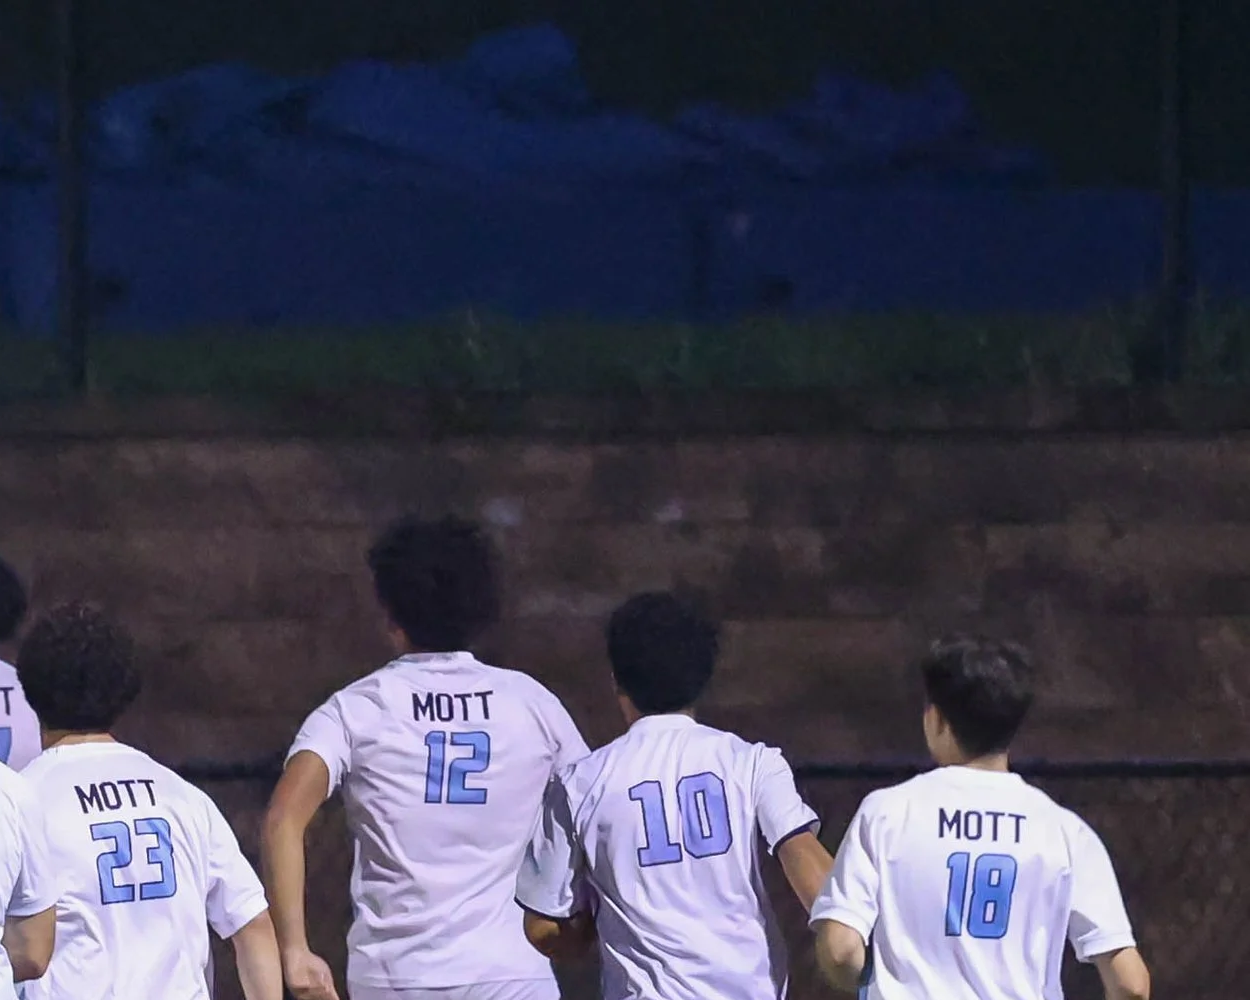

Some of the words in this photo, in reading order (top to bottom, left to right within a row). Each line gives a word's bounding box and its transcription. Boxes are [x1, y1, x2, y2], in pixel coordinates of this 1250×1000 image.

[411, 689, 494, 722] MOTT
[73, 778, 156, 816] MOTT
[423, 729, 492, 805] 12
[627, 770, 734, 868] 10
[937, 807, 1028, 845] MOTT
[89, 816, 178, 905] 23
[944, 851, 1018, 940] 18
